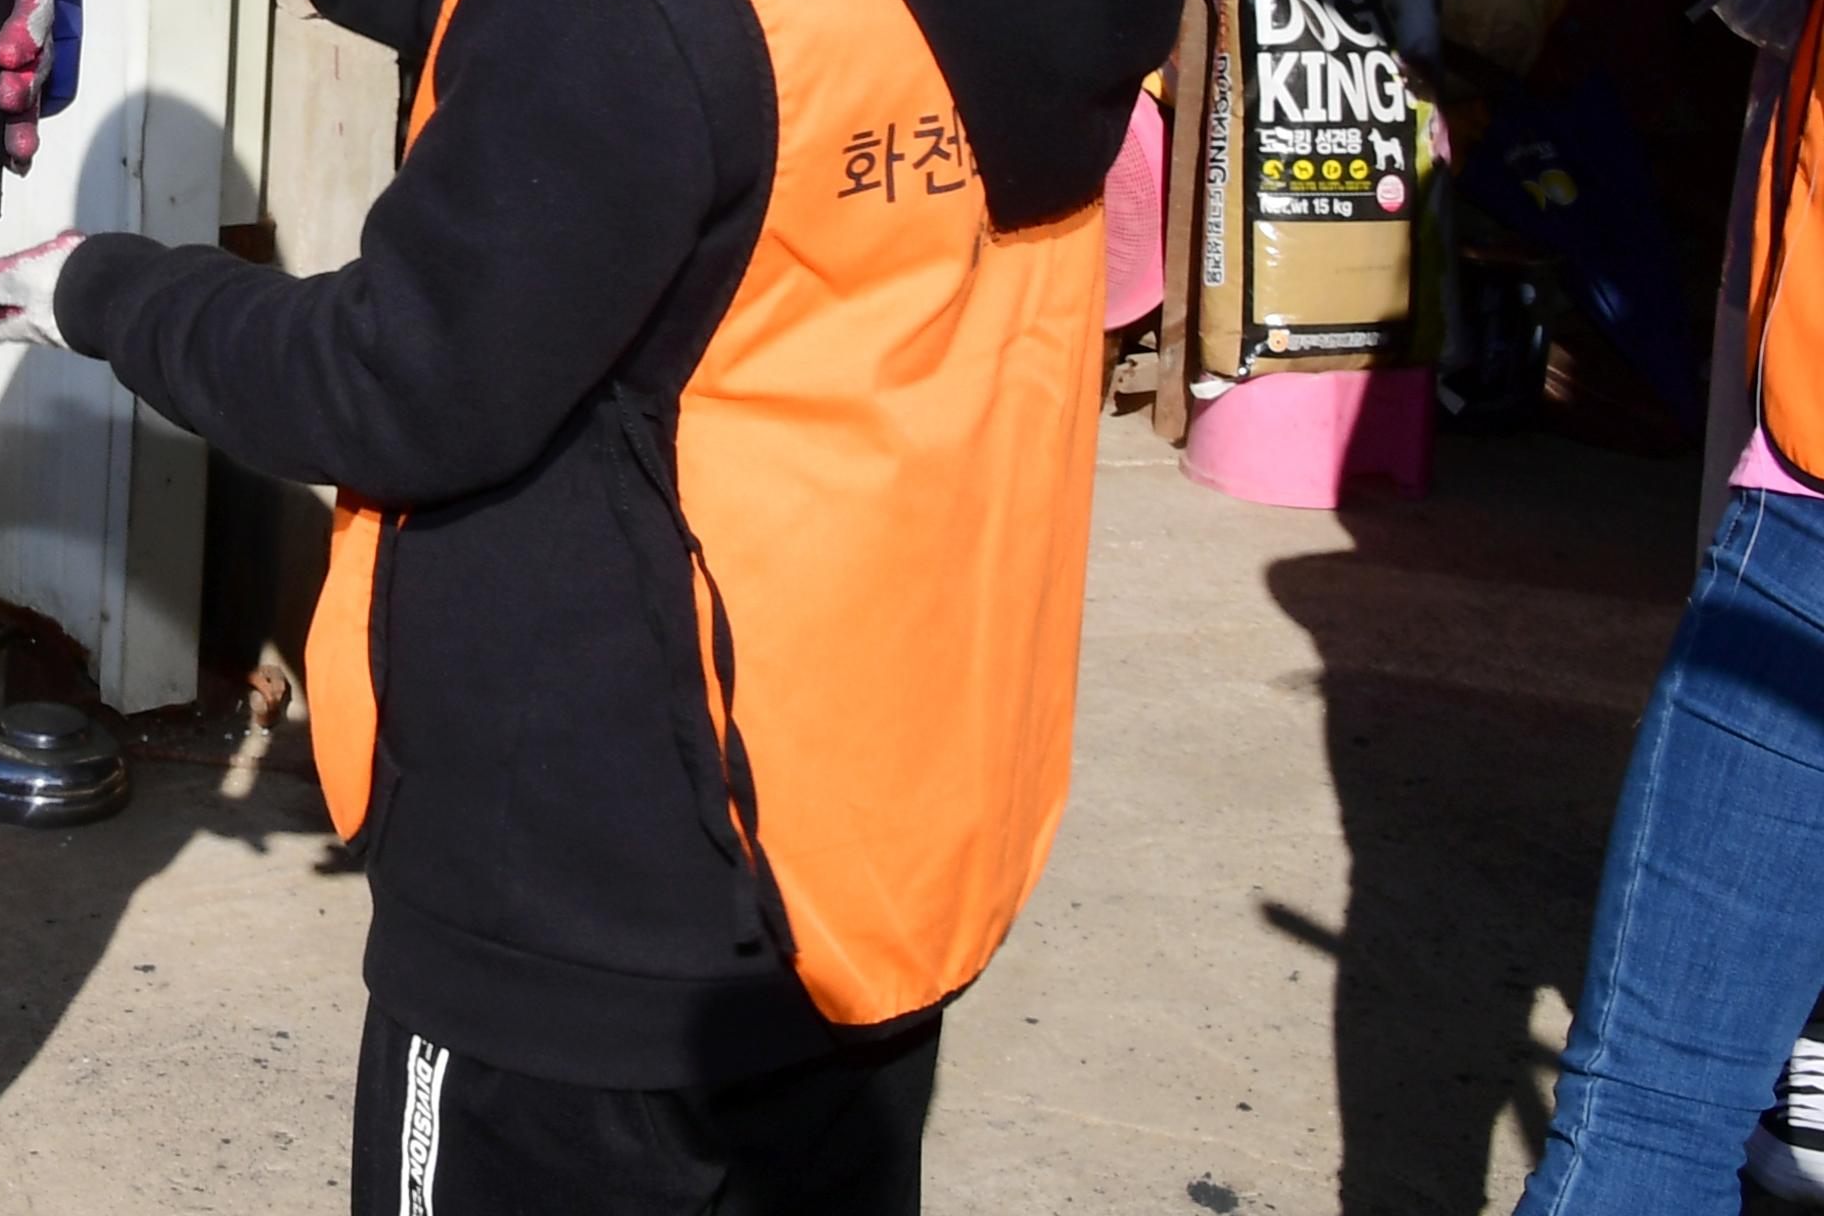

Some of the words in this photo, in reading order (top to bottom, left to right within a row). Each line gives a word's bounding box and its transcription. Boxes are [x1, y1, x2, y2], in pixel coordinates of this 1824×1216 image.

[1257, 50, 1406, 122] KING
[837, 106, 980, 203] 화천
[1315, 128, 1363, 155] 성견용
[1313, 197, 1330, 215] 15
[1333, 197, 1353, 218] kg
[409, 1057, 433, 1186] DIVISION
